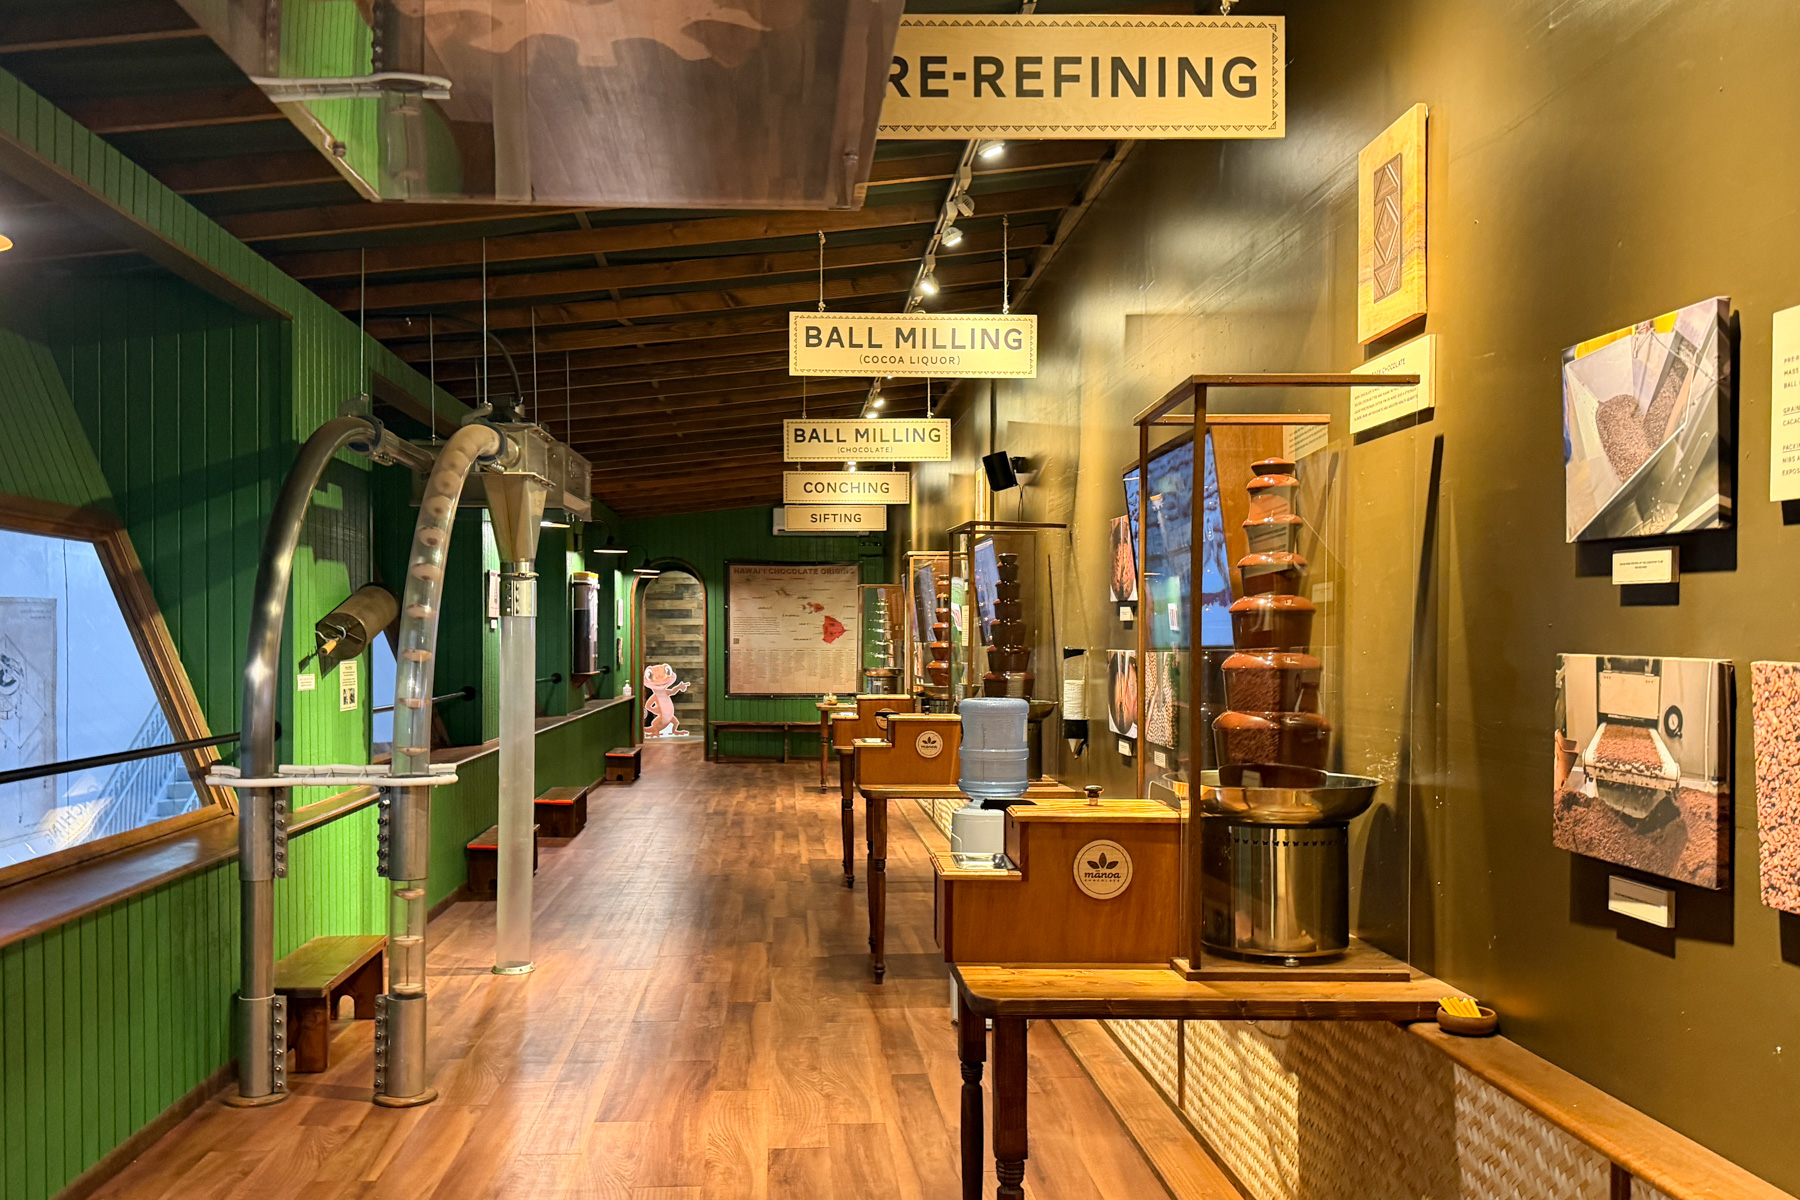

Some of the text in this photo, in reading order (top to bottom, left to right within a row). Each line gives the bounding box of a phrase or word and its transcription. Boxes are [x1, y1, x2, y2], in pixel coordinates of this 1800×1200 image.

[888, 55, 1258, 98] RE-REFINING
[805, 326, 1022, 350] BALL MILLING
[859, 354, 961, 366] (COCOA LIQUOR)
[794, 428, 941, 443] BALL MILLING
[837, 446, 893, 454] (CHOCOLATE)
[803, 482, 890, 493] CONCHING
[810, 513, 862, 523] SIFTING
[768, 567, 819, 575] CHOCOLATE
[821, 567, 856, 575] ORIGINS
